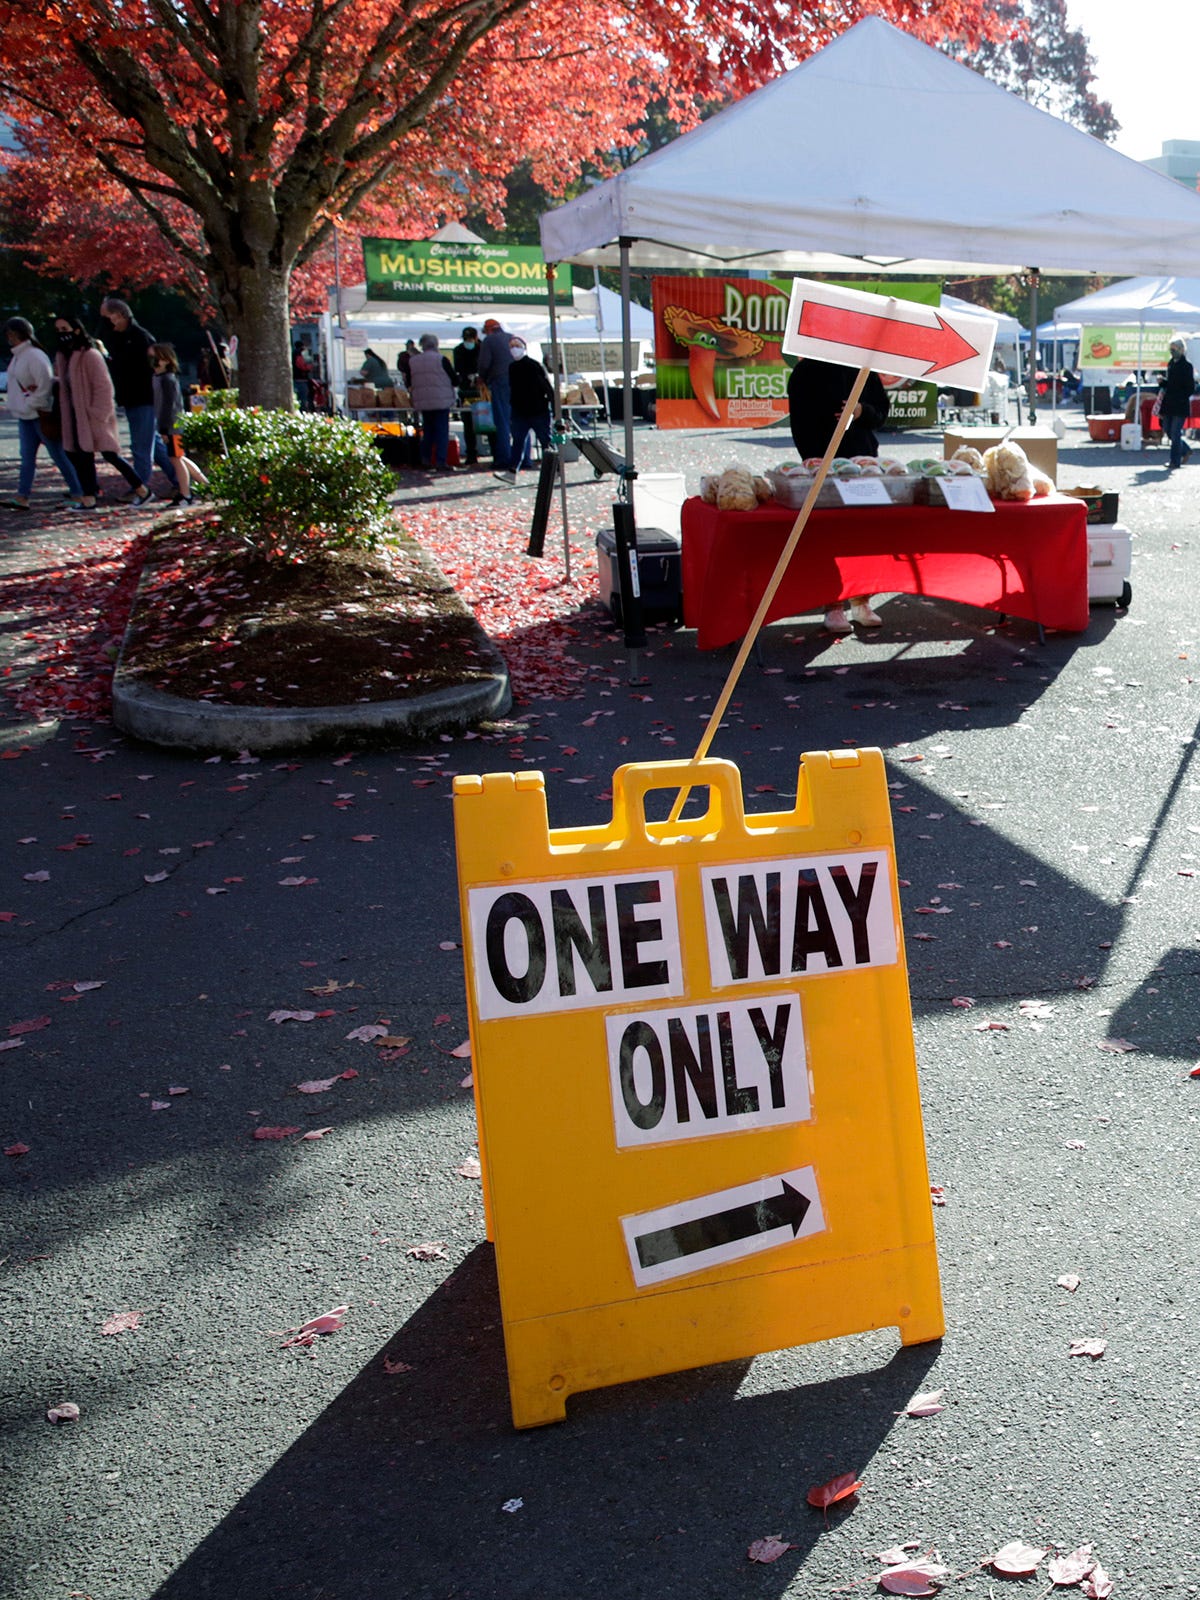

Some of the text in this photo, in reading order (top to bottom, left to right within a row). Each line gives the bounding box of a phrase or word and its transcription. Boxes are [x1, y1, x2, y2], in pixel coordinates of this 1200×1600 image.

[430, 243, 509, 260] Certified Organic
[380, 253, 559, 280] MUSHROOMS
[393, 280, 549, 296] RAIN FOREST MUSHROOMS
[728, 399, 772, 409] All Natural
[486, 861, 880, 1005] ONE WAY
[619, 1003, 792, 1131] ONLY
